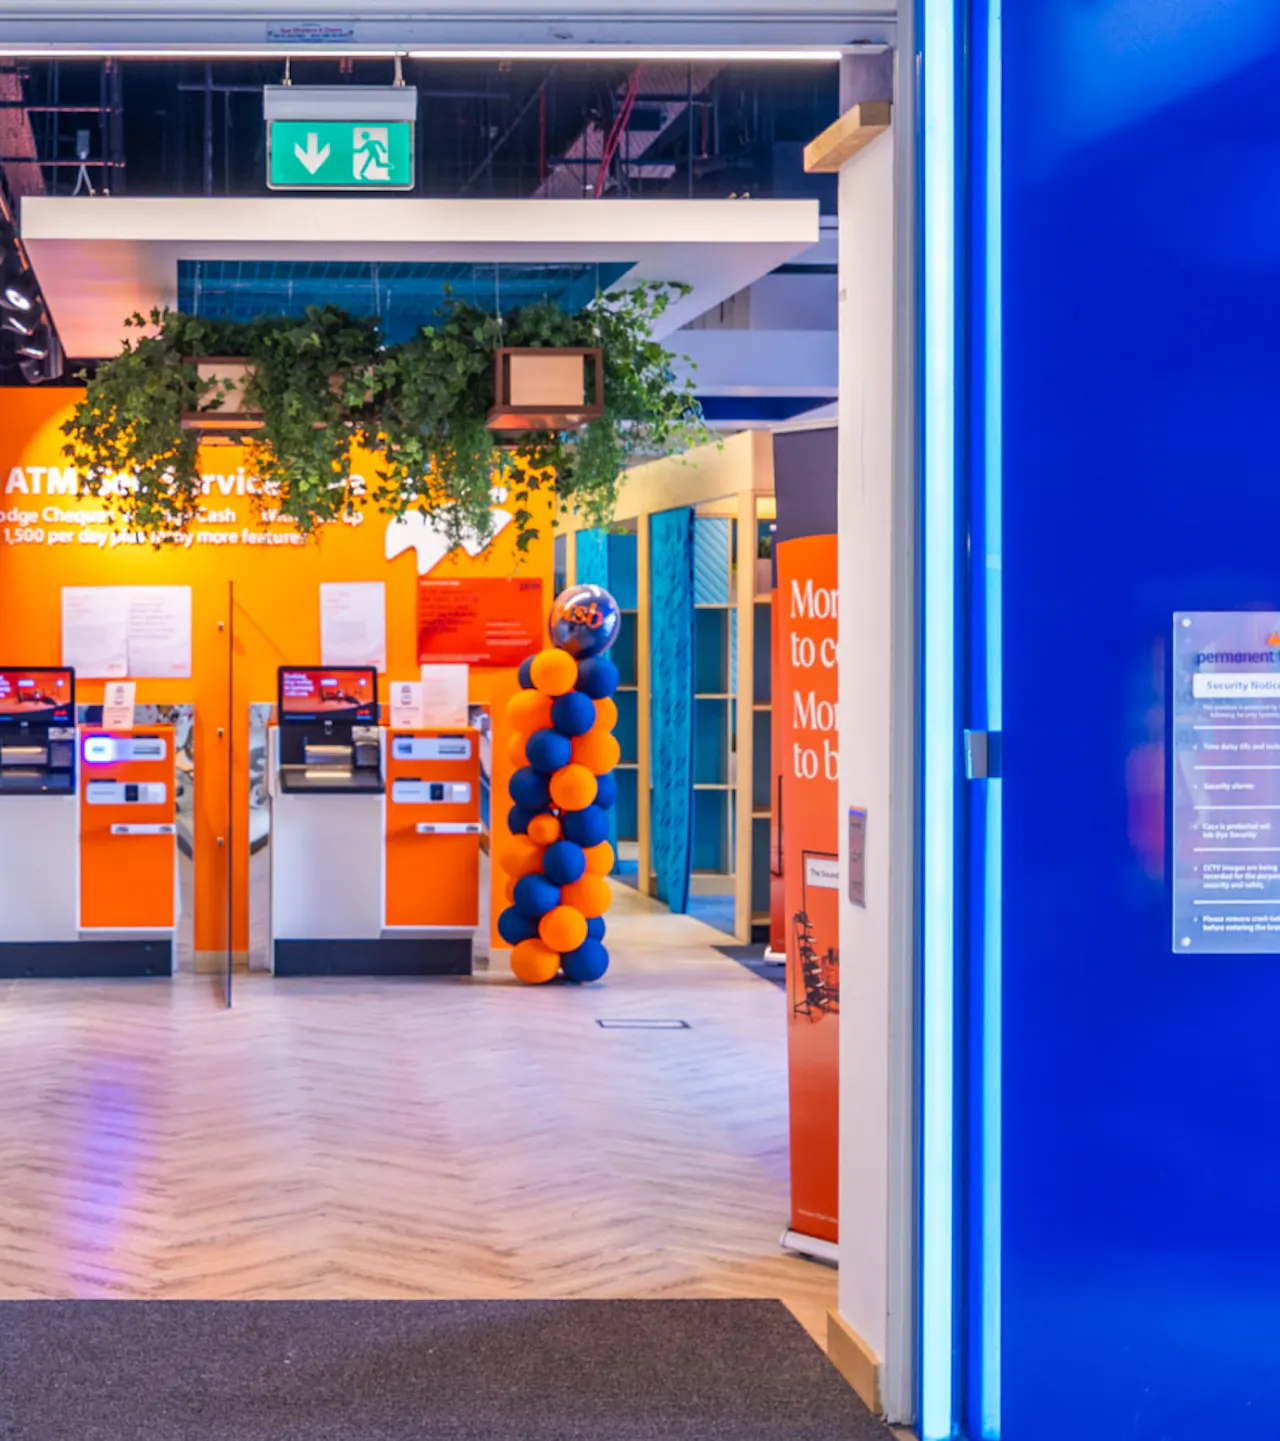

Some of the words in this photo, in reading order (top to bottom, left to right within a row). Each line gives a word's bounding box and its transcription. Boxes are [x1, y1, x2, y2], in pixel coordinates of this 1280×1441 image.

[165, 466, 280, 496] rvice
[197, 507, 236, 523] Cash
[4, 528, 45, 545] 1,500
[48, 531, 75, 545] per
[78, 528, 108, 548] day
[197, 530, 239, 544] more
[791, 632, 816, 668] to
[821, 637, 839, 669] c
[1195, 650, 1275, 667] permanent
[1207, 681, 1248, 692] Security
[793, 743, 818, 780] to
